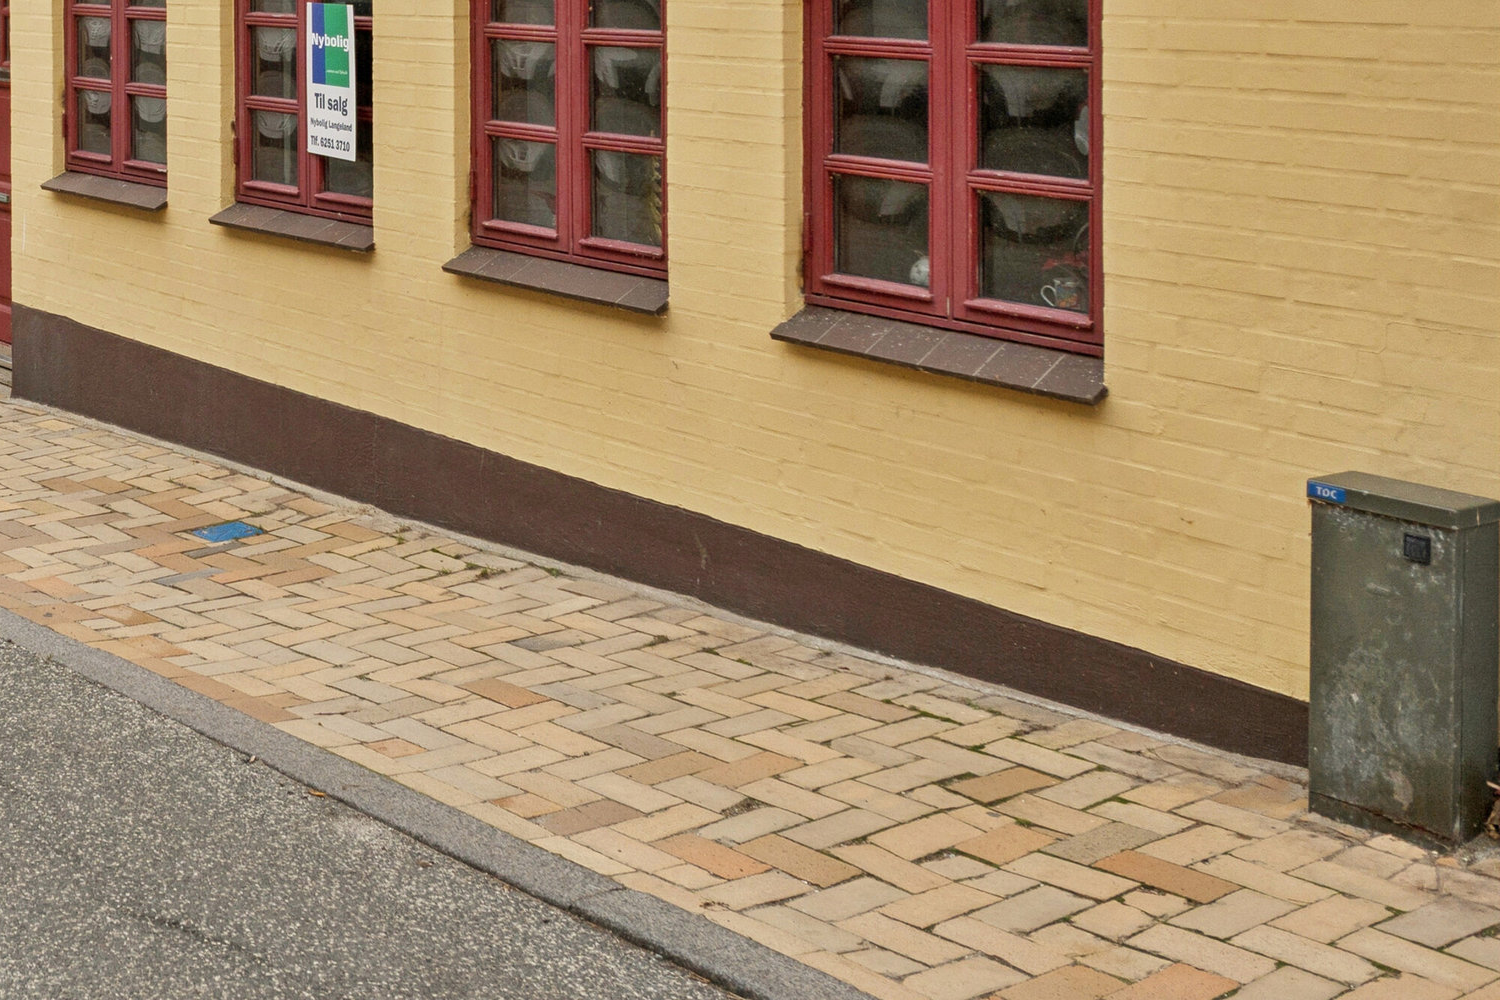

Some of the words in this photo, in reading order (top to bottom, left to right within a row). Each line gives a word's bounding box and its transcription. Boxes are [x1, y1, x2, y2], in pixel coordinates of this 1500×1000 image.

[311, 33, 349, 52] Nybolig
[314, 92, 326, 109] Til
[327, 96, 348, 116] salg
[310, 117, 328, 129] Nybolig
[328, 120, 352, 132] Langeland
[310, 135, 320, 146] Tlf.
[320, 137, 334, 149] 6251
[335, 139, 351, 152] 3710
[1315, 486, 1337, 499] TDC
